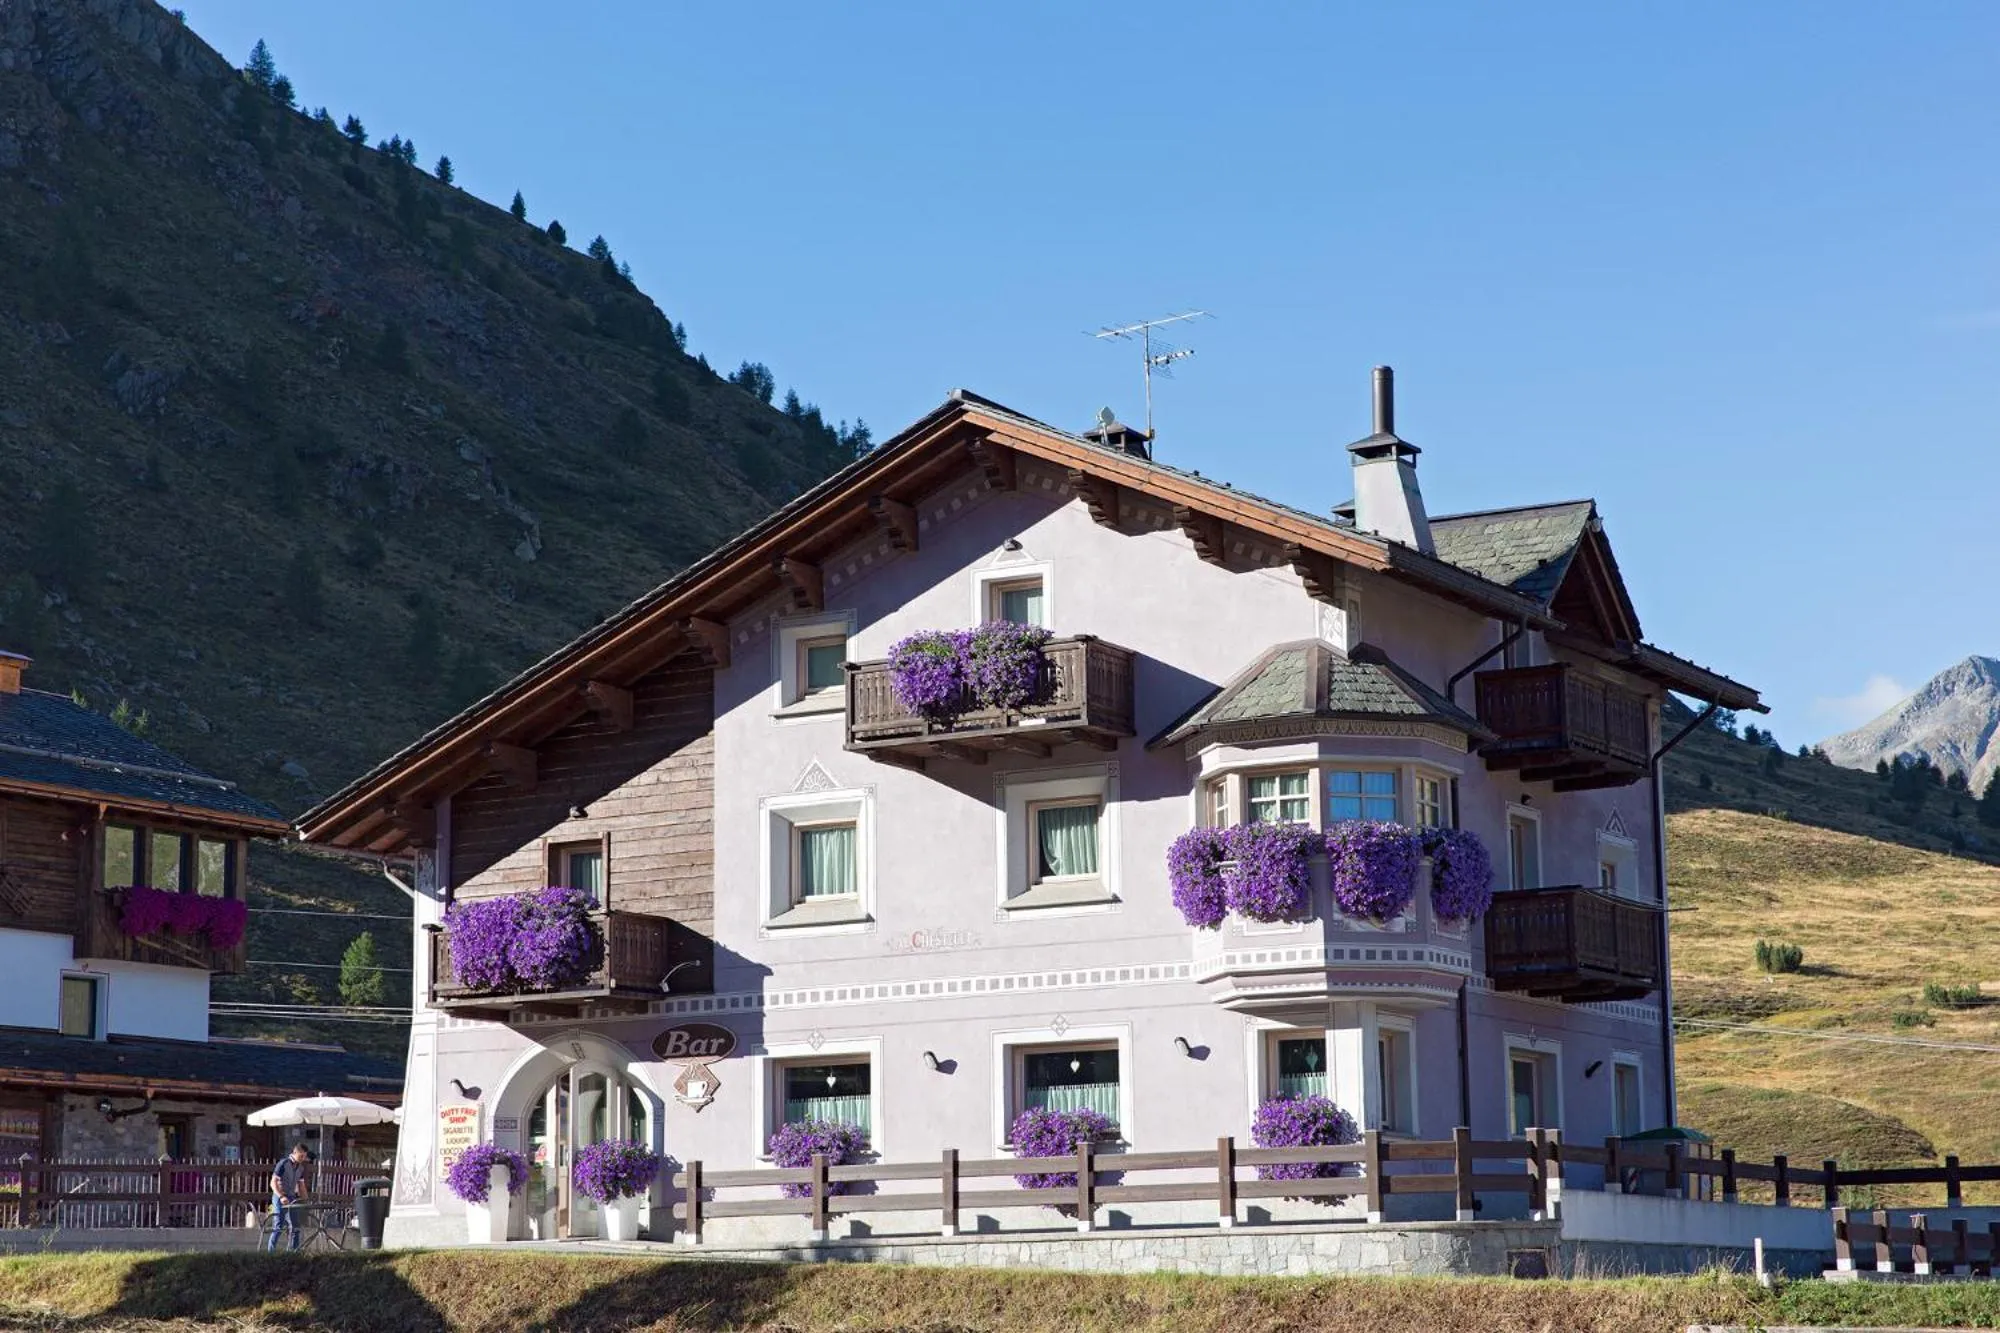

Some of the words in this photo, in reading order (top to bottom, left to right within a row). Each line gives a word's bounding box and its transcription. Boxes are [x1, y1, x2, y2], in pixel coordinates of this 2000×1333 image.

[664, 1031, 725, 1055] Bar
[440, 1108, 459, 1118] DUTY
[460, 1107, 477, 1116] FREE
[449, 1116, 467, 1124] SHOP
